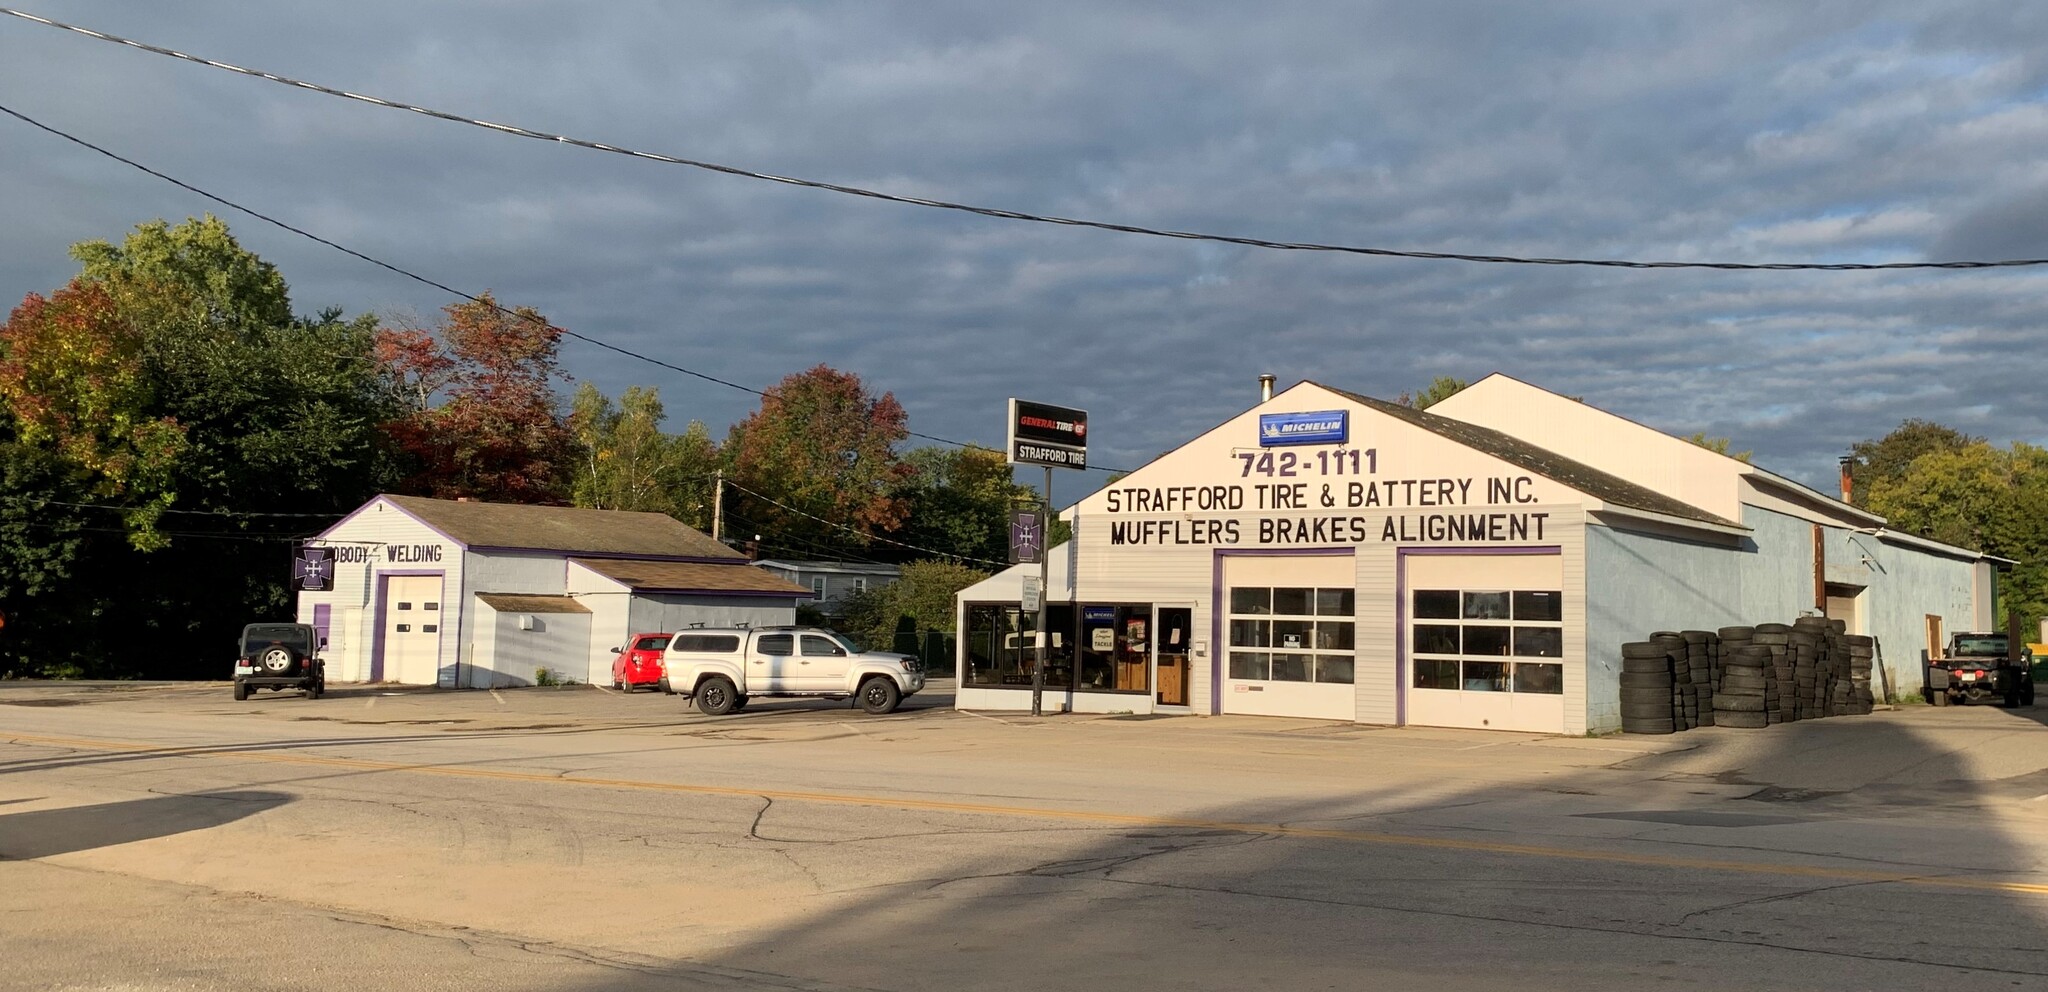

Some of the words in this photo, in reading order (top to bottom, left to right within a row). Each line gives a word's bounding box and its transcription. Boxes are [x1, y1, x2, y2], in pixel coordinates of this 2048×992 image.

[1281, 420, 1341, 432] MICHELIN
[1019, 445, 1067, 463] STRAFFORD
[1067, 451, 1085, 465] TIRE
[1238, 448, 1377, 478] 742-1111
[1106, 485, 1244, 513] STRAFFORD
[1254, 483, 1308, 509] TIRE
[1320, 483, 1335, 508] &
[1347, 477, 1473, 508] BATTERY
[1486, 476, 1539, 504] INC.
[1111, 518, 1240, 545] MUFFLERS
[1259, 516, 1366, 544] BRAKES
[1381, 512, 1549, 542] ALIGNMENT
[387, 544, 442, 563] WELDING
